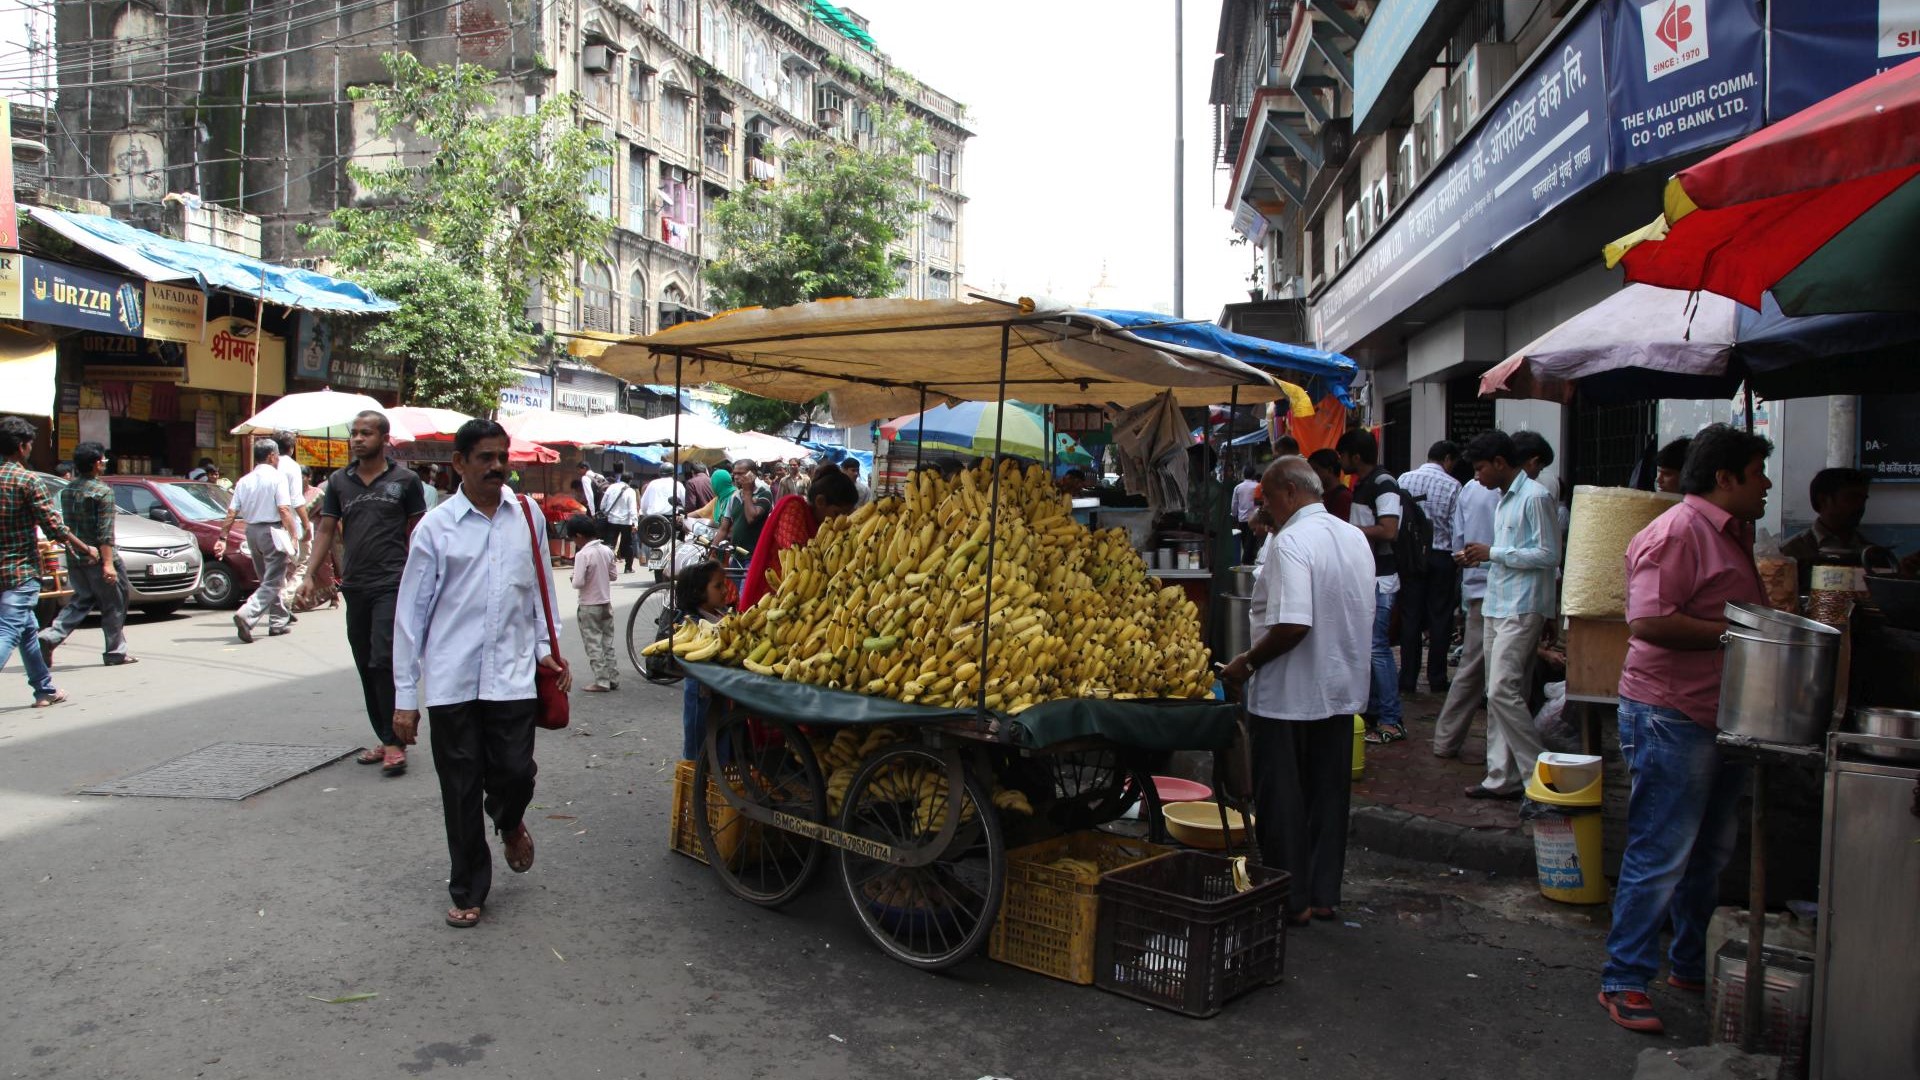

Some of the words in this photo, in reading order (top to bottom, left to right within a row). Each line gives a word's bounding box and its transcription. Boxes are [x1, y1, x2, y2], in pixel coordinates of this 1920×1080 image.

[1897, 29, 1920, 48] SI
[1563, 45, 1587, 99] लि.
[1653, 56, 1676, 73] SINCE
[1681, 47, 1701, 62] 1970
[1621, 108, 1645, 132] THE
[1646, 90, 1705, 125] KALUPUR
[1708, 71, 1759, 101] COMM.
[1677, 109, 1715, 134] BANK
[1717, 96, 1749, 120] LTD.
[53, 282, 111, 312] URZZA
[152, 287, 199, 306] VAFADAR
[501, 392, 519, 405] OM
[525, 395, 543, 409] SAI
